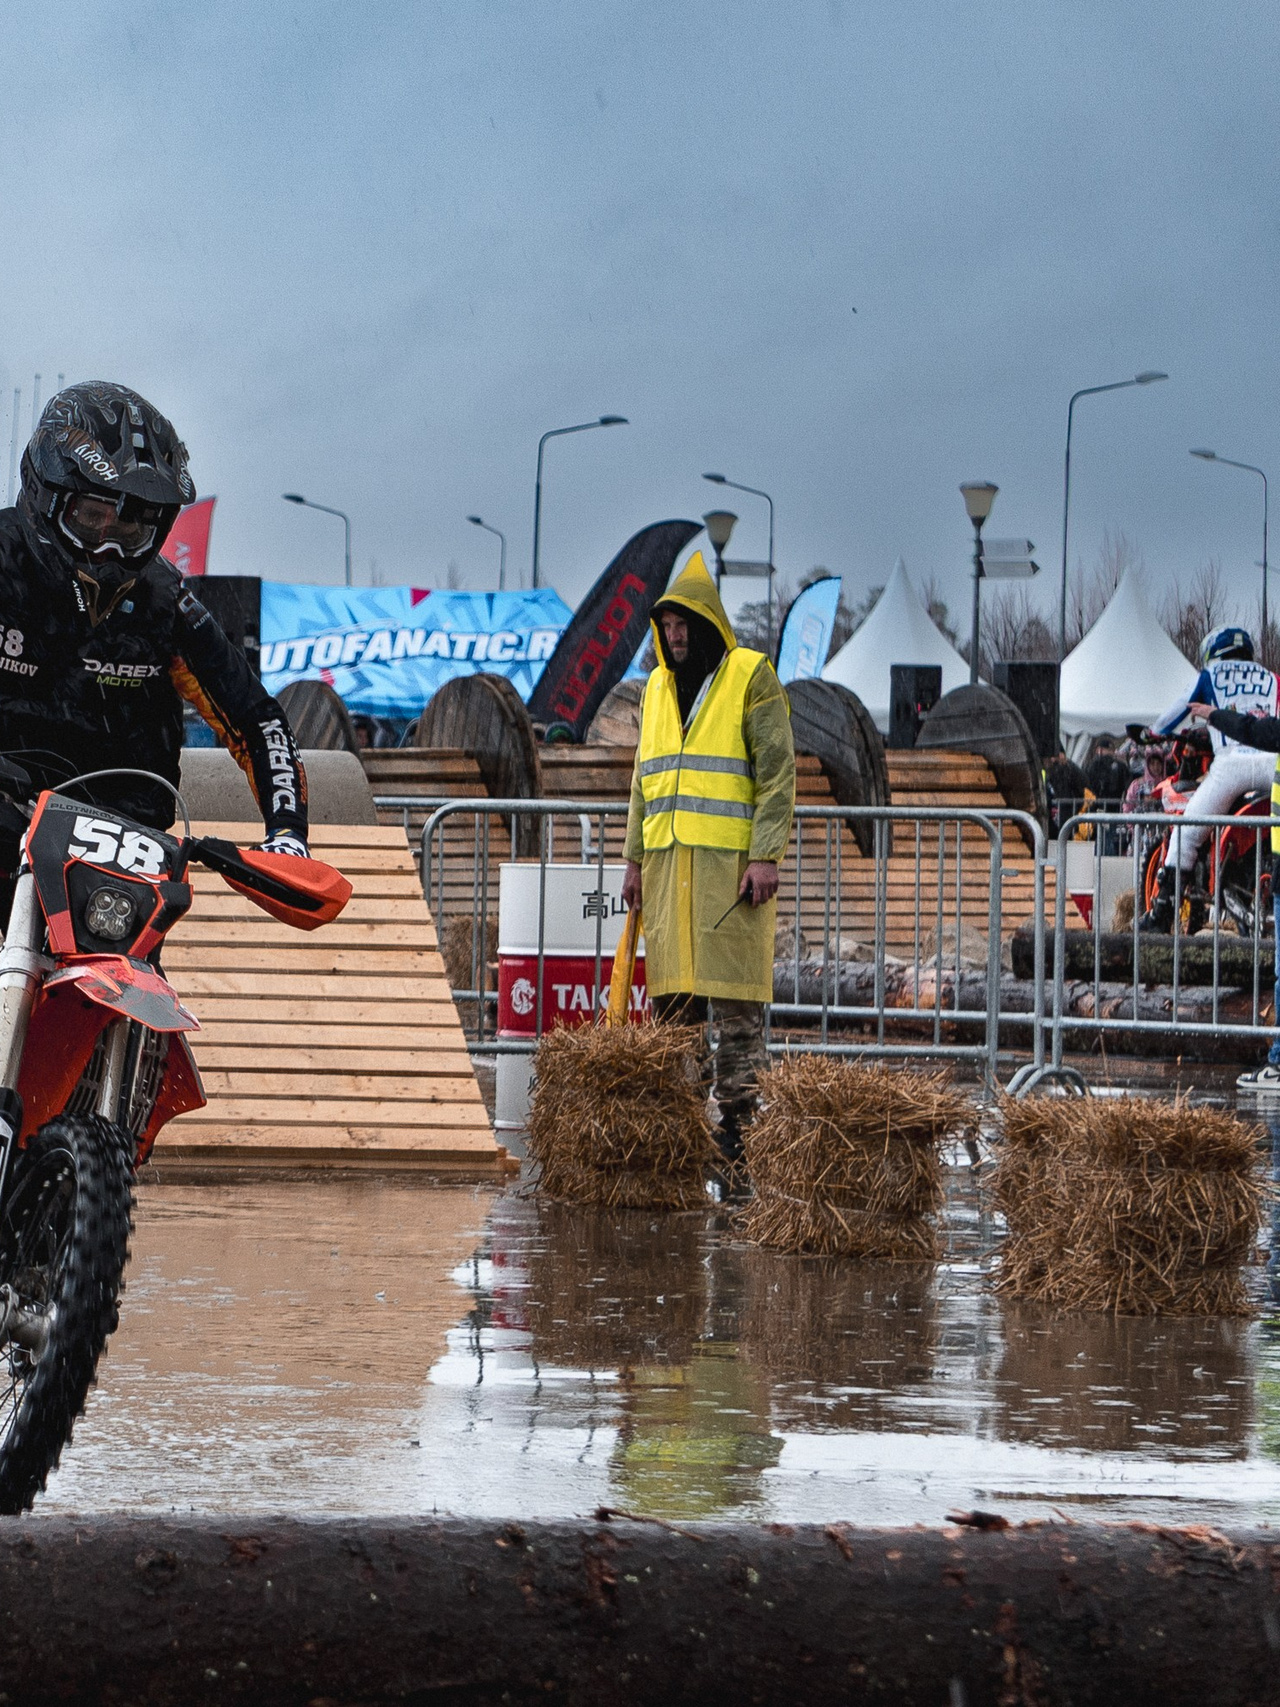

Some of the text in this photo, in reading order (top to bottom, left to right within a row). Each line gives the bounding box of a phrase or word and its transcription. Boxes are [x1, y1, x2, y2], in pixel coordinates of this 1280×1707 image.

[74, 443, 119, 482] AIROH
[260, 628, 563, 673] UTOFANATIC.R
[82, 658, 163, 677] DAREX
[96, 675, 142, 687] MOTO
[1215, 670, 1273, 697] 444
[259, 718, 297, 814] DAREX
[50, 802, 115, 820] PLOTNIKOV
[68, 815, 165, 882] 58
